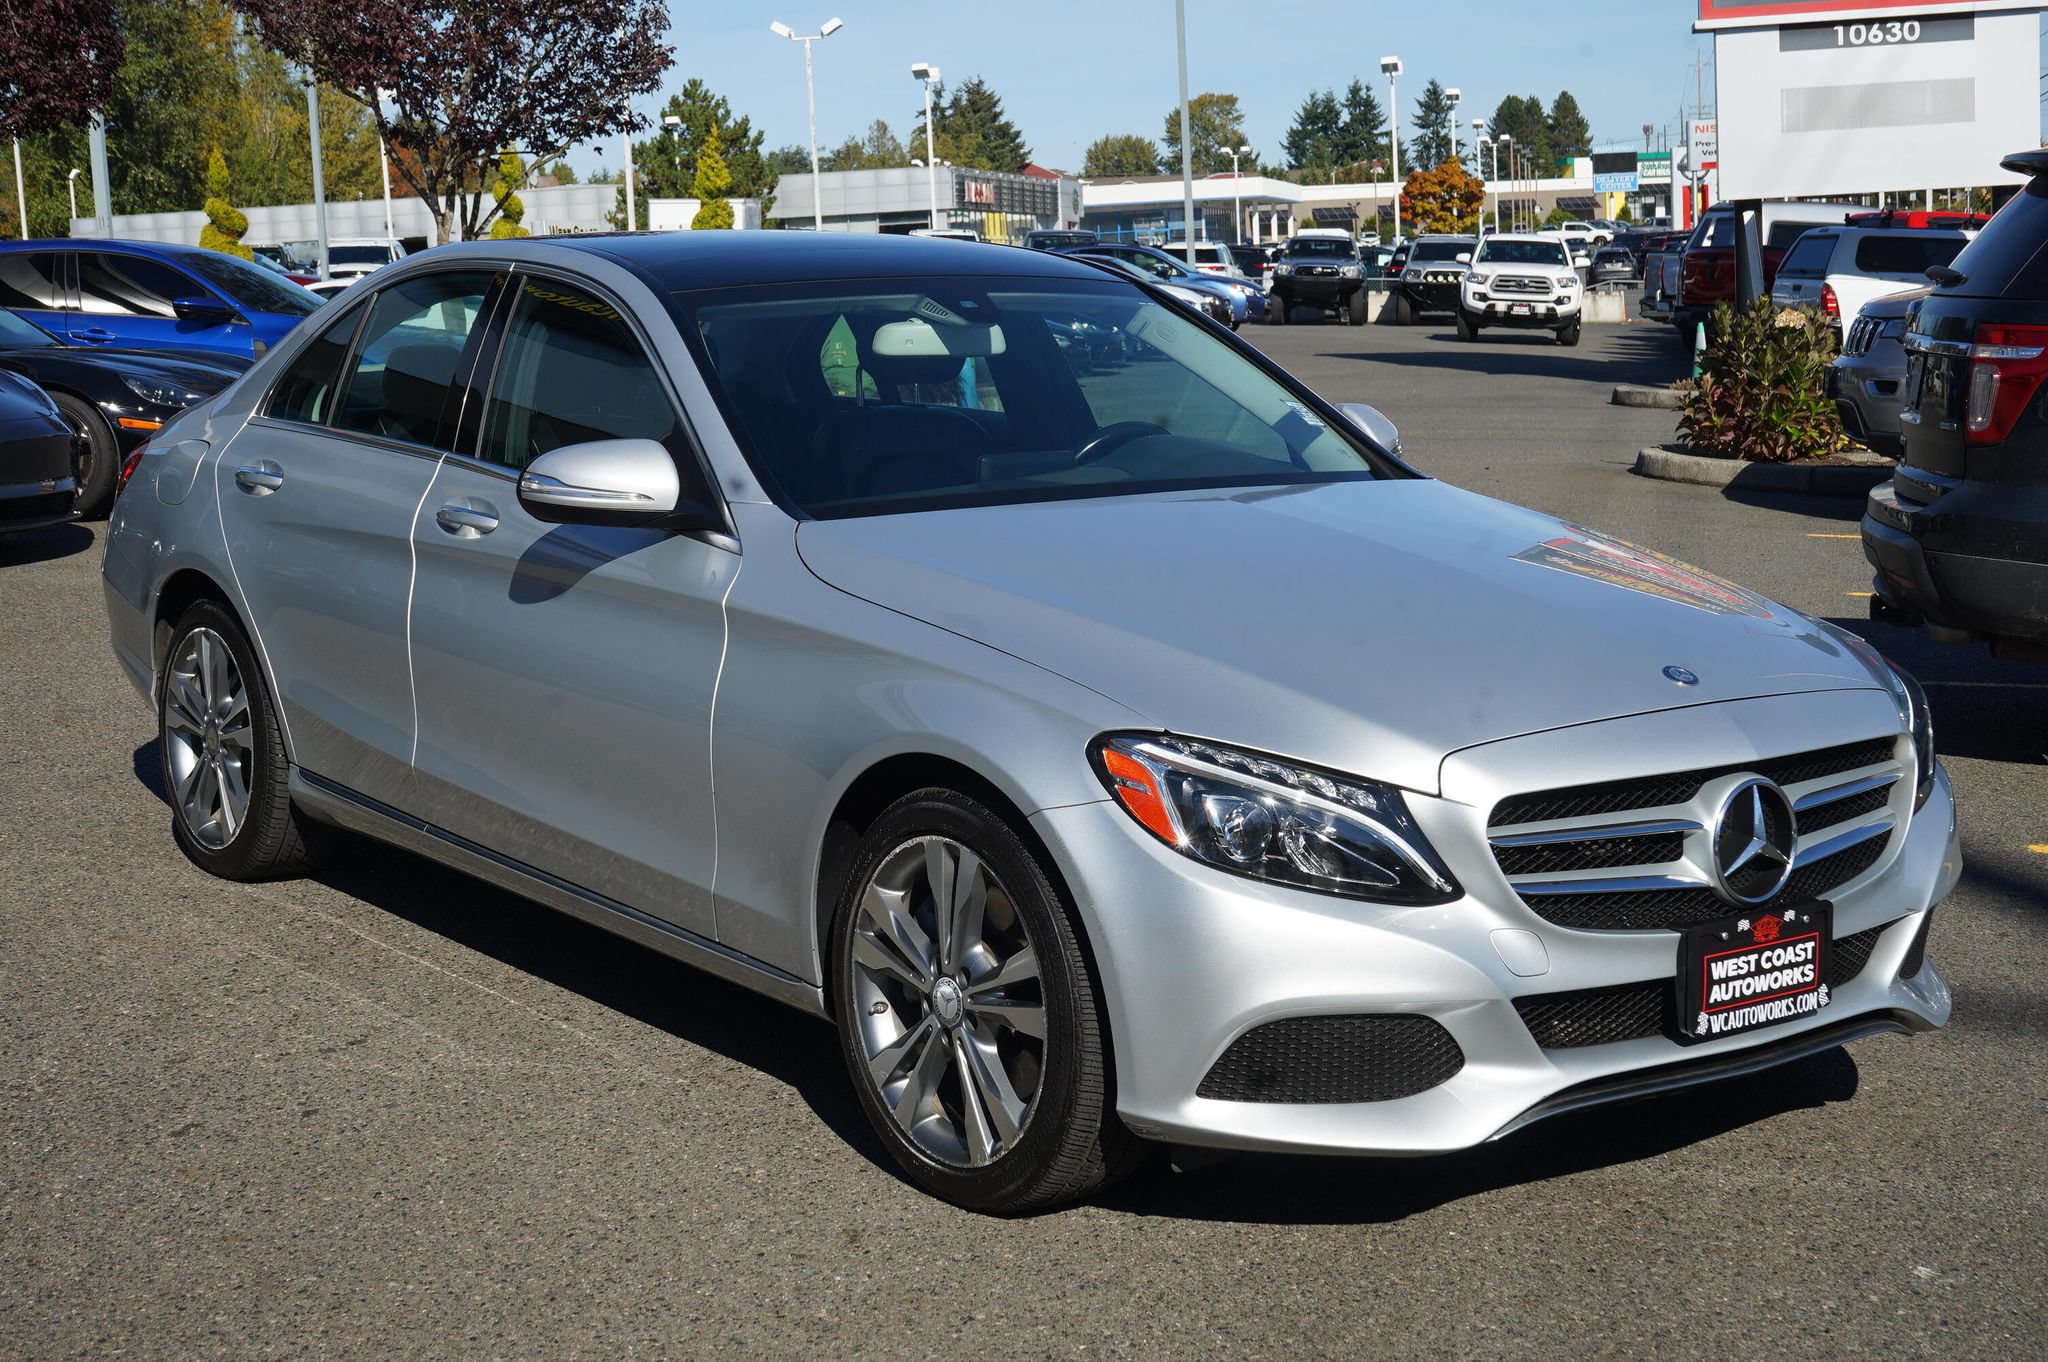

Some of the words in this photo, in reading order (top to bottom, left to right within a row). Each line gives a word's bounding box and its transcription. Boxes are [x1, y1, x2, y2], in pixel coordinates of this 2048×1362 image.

[1833, 21, 1921, 46] 10630
[1596, 174, 1636, 184] DELIVERY
[1599, 182, 1633, 190] CENTER
[1710, 953, 1759, 980] WEST
[1760, 941, 1815, 970] COAST
[1709, 964, 1815, 1004] AUTOWORKS
[1709, 991, 1818, 1034] WCAUTOWORKS.COM
